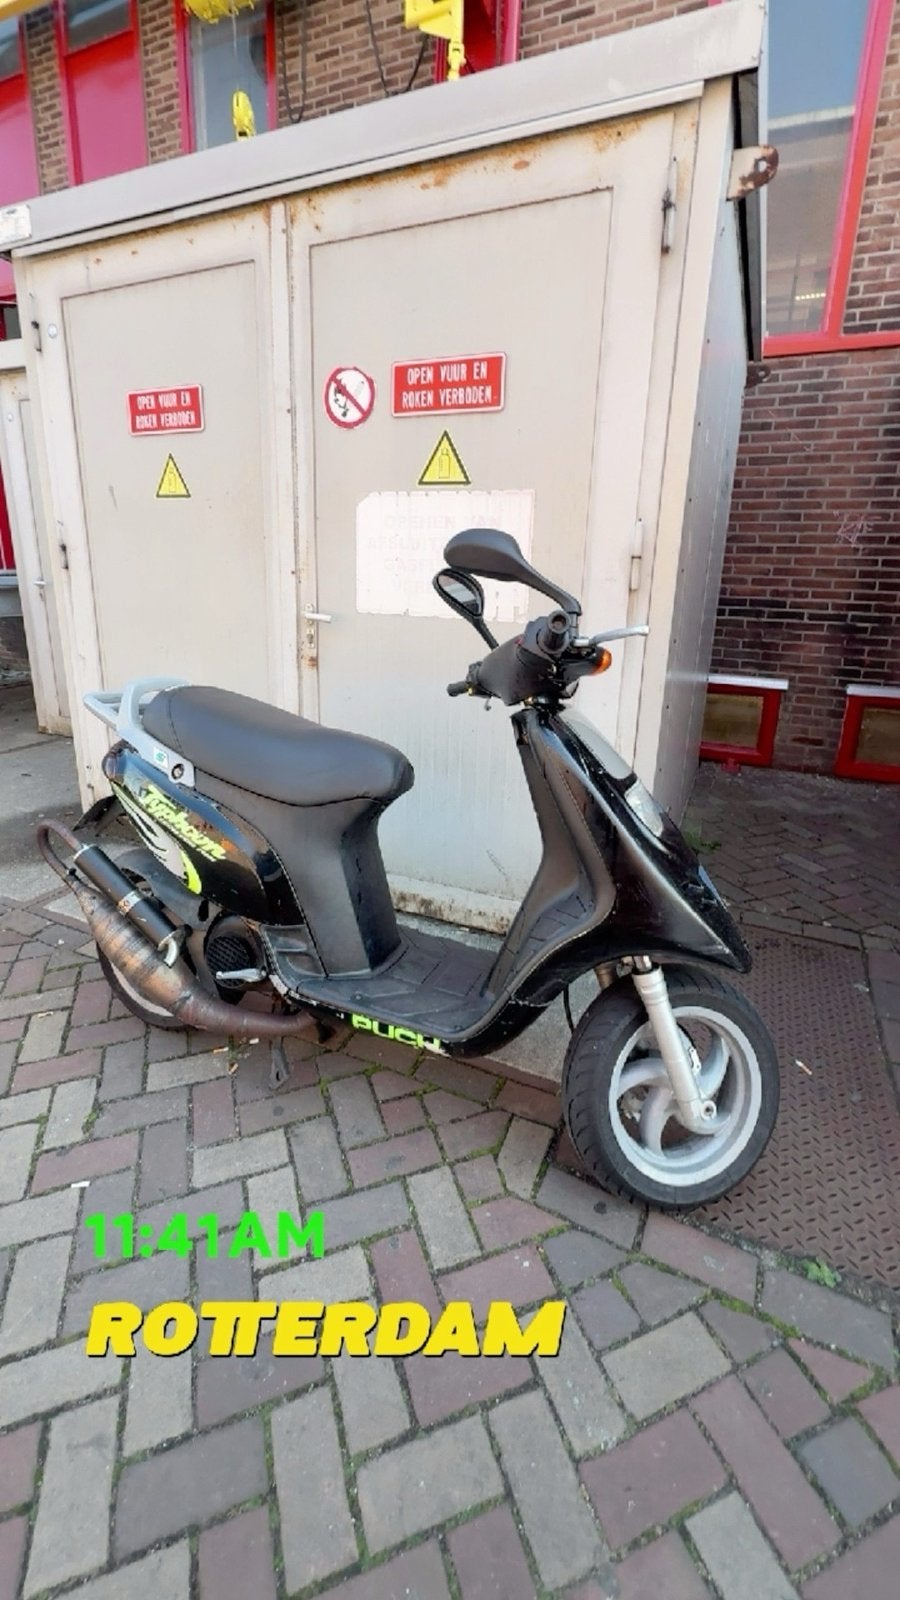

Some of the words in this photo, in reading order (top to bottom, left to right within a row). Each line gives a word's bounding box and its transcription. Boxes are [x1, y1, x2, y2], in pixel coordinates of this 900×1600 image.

[407, 365, 433, 385] OPEN
[440, 363, 467, 382] VUUR
[473, 361, 488, 379] EN
[136, 394, 156, 410] OPEN
[158, 392, 178, 408] VUUR
[180, 391, 192, 406] EN
[402, 390, 434, 409] ROKEN
[439, 386, 492, 406] VERBODEN
[135, 413, 158, 429] ROKEN
[160, 410, 196, 427] VERBODEN
